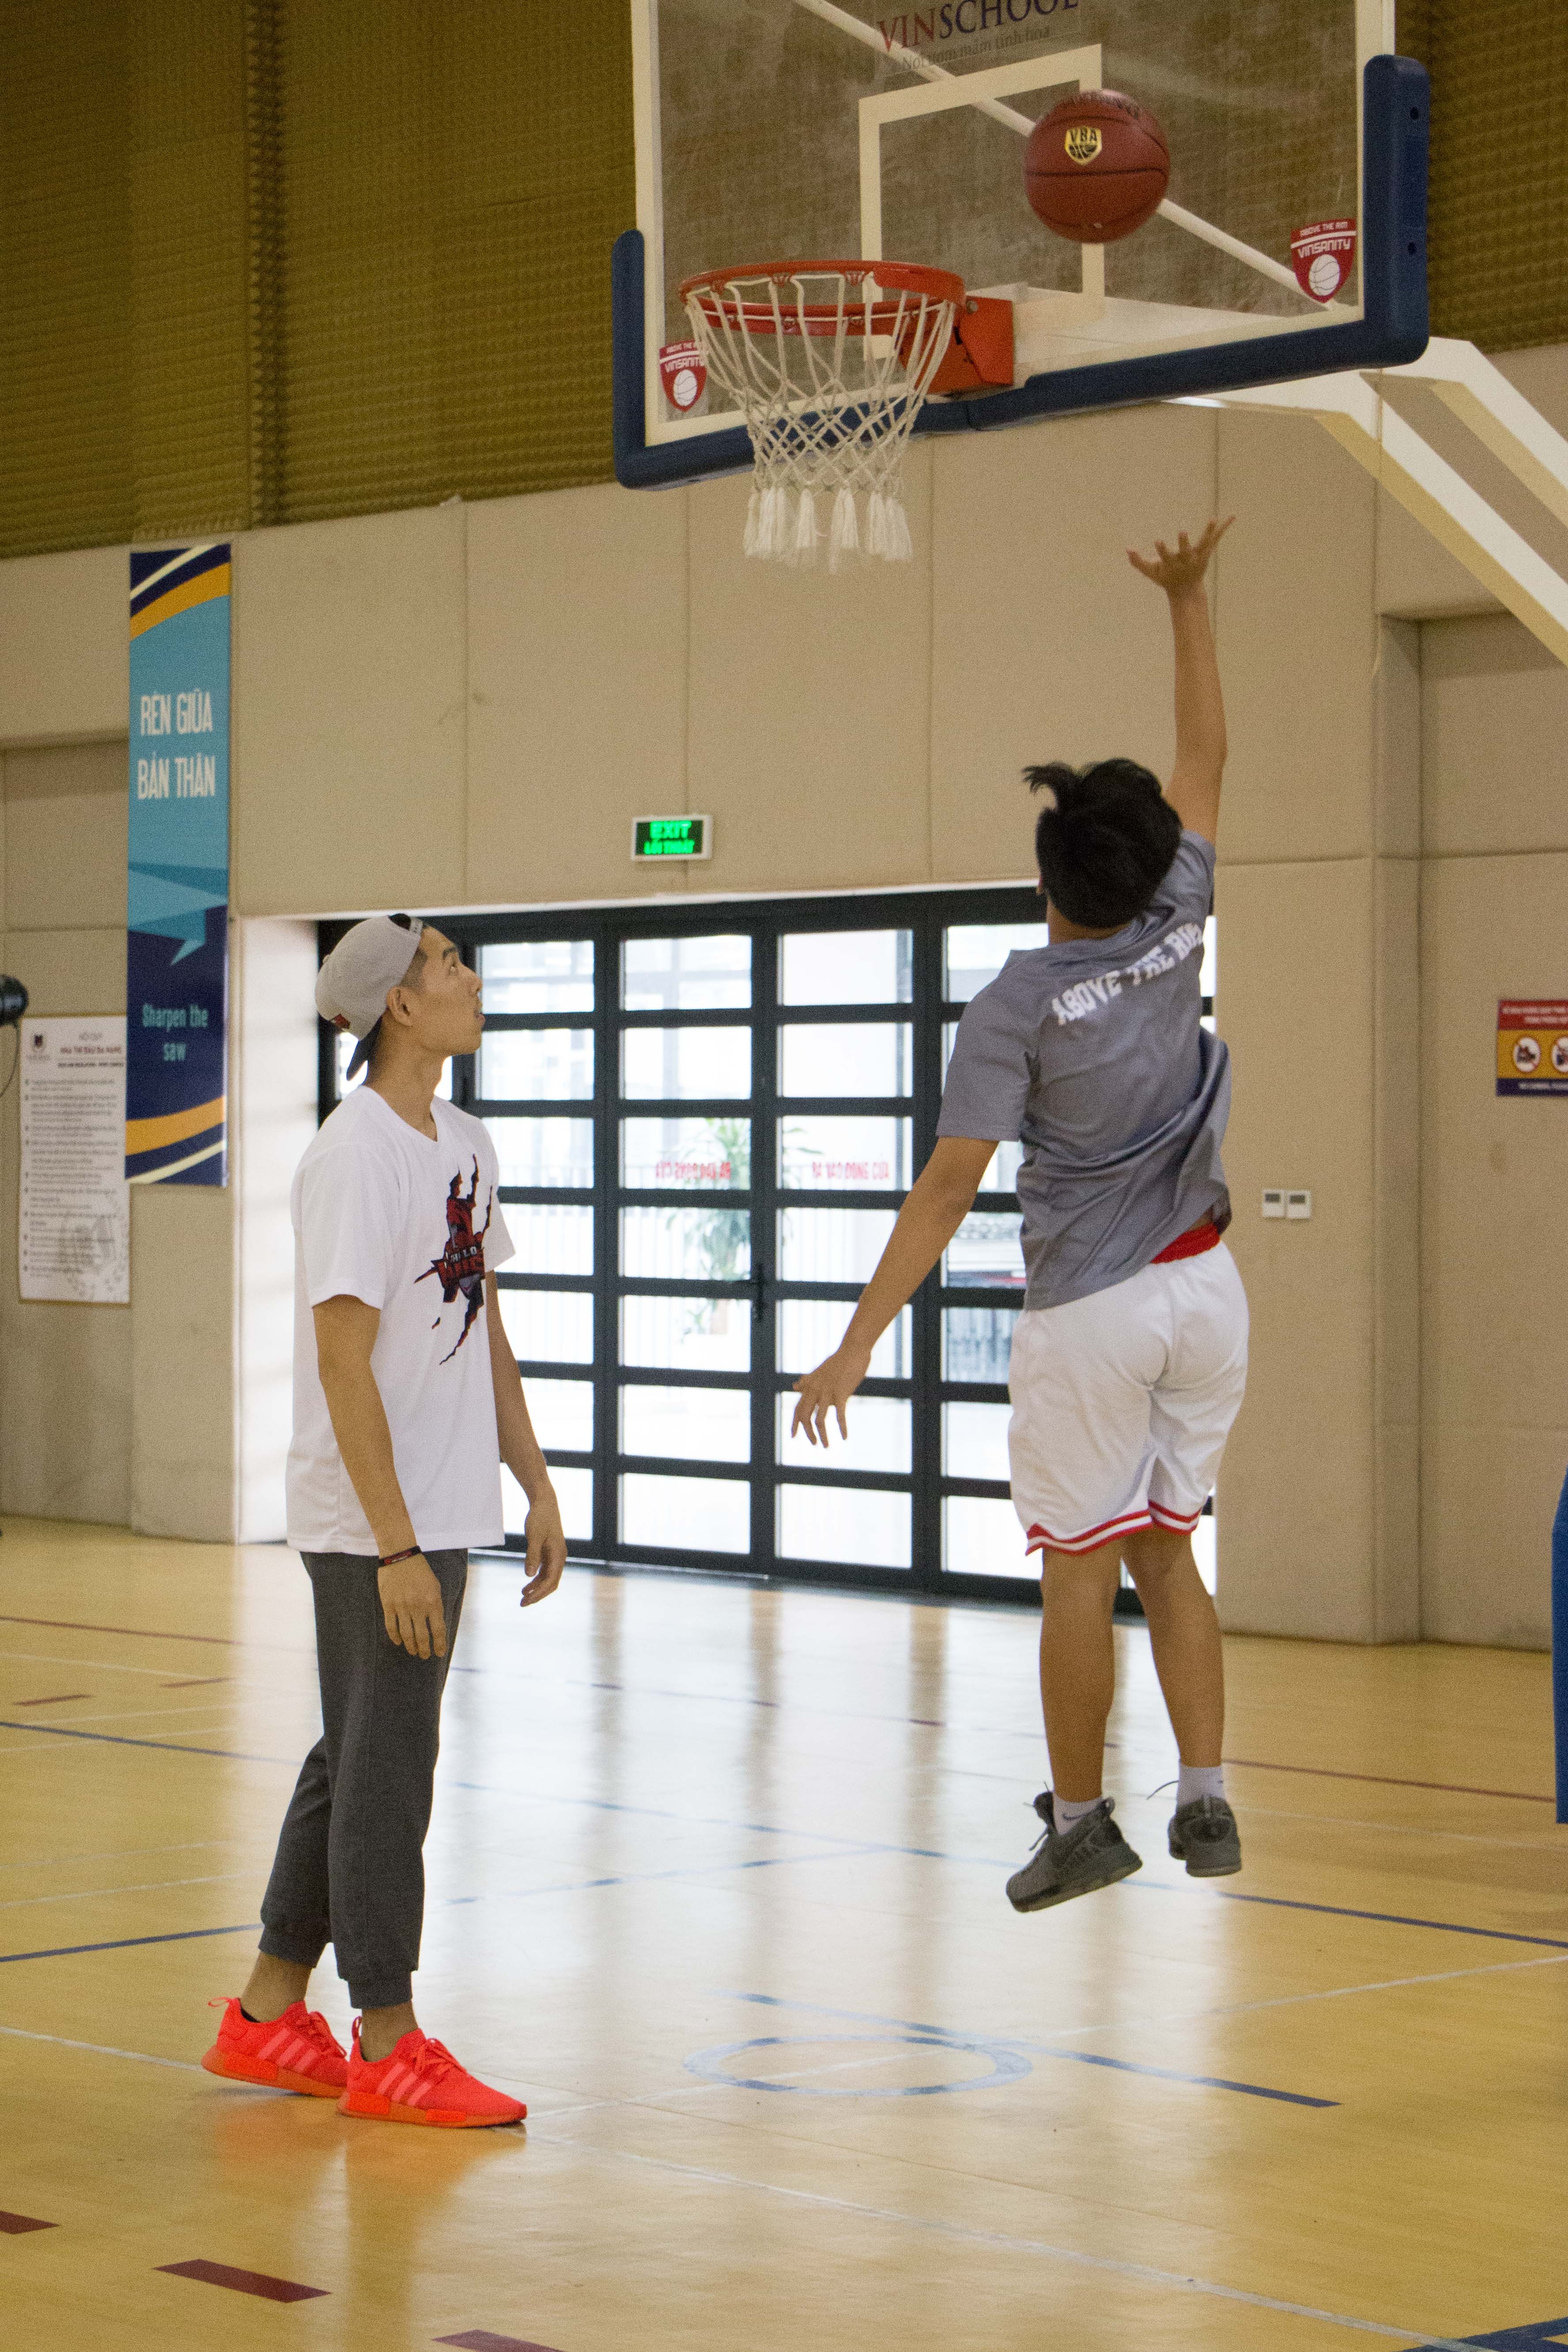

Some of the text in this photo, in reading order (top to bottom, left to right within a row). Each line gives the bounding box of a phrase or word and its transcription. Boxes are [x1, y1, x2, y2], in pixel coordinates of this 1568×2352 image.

[1298, 239, 1351, 258] VINSANITY
[650, 820, 692, 839] EXIT
[1052, 970, 1122, 1026] ABOVE
[1126, 945, 1176, 987] THE
[142, 1003, 208, 1033] Sharpen the
[163, 1042, 186, 1061] saw
